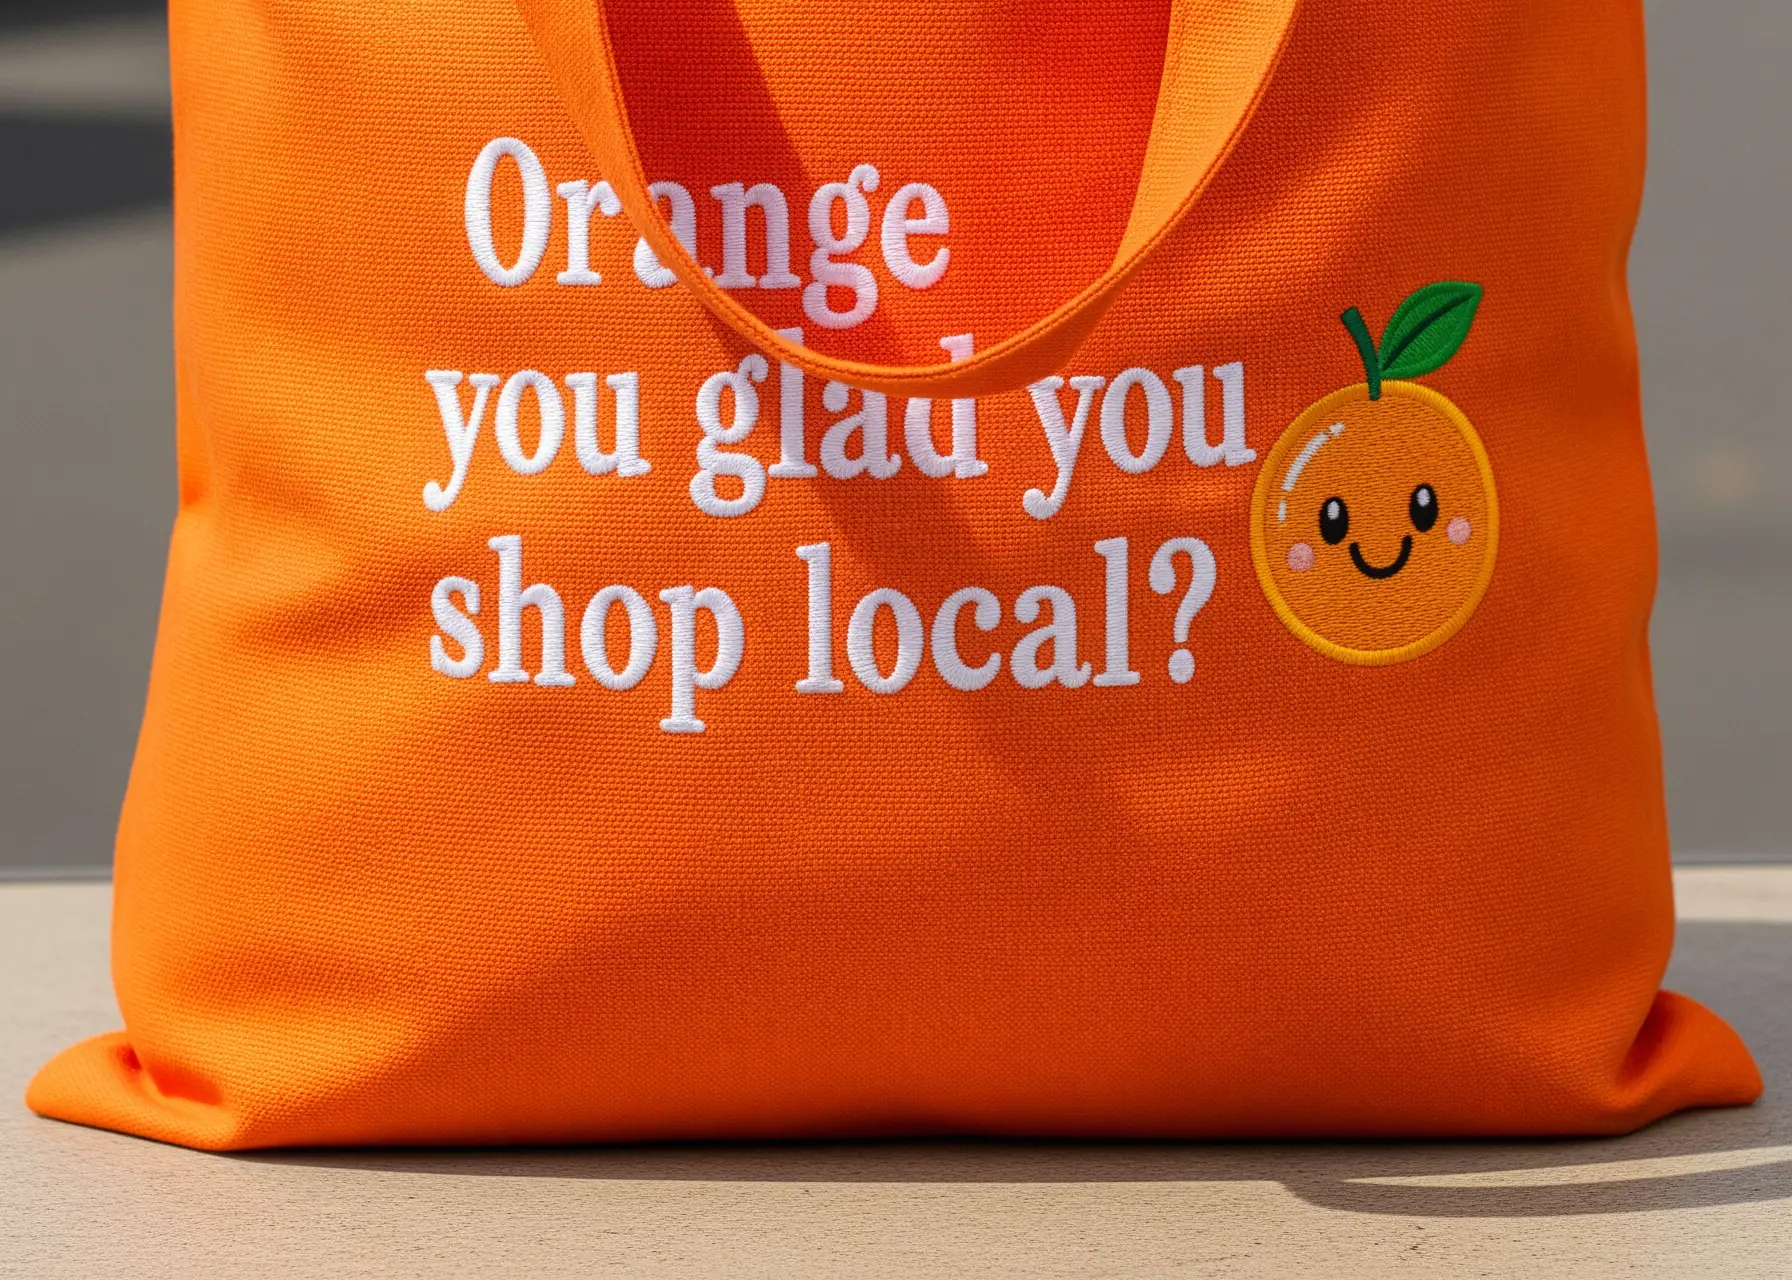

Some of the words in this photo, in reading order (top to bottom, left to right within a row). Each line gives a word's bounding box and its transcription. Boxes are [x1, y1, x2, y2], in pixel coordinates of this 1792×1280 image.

[465, 136, 951, 329] Orange
[422, 368, 652, 513] you
[689, 326, 989, 518] glad
[1022, 361, 1257, 520] you
[430, 534, 745, 733] shop
[795, 536, 1217, 694] local?
